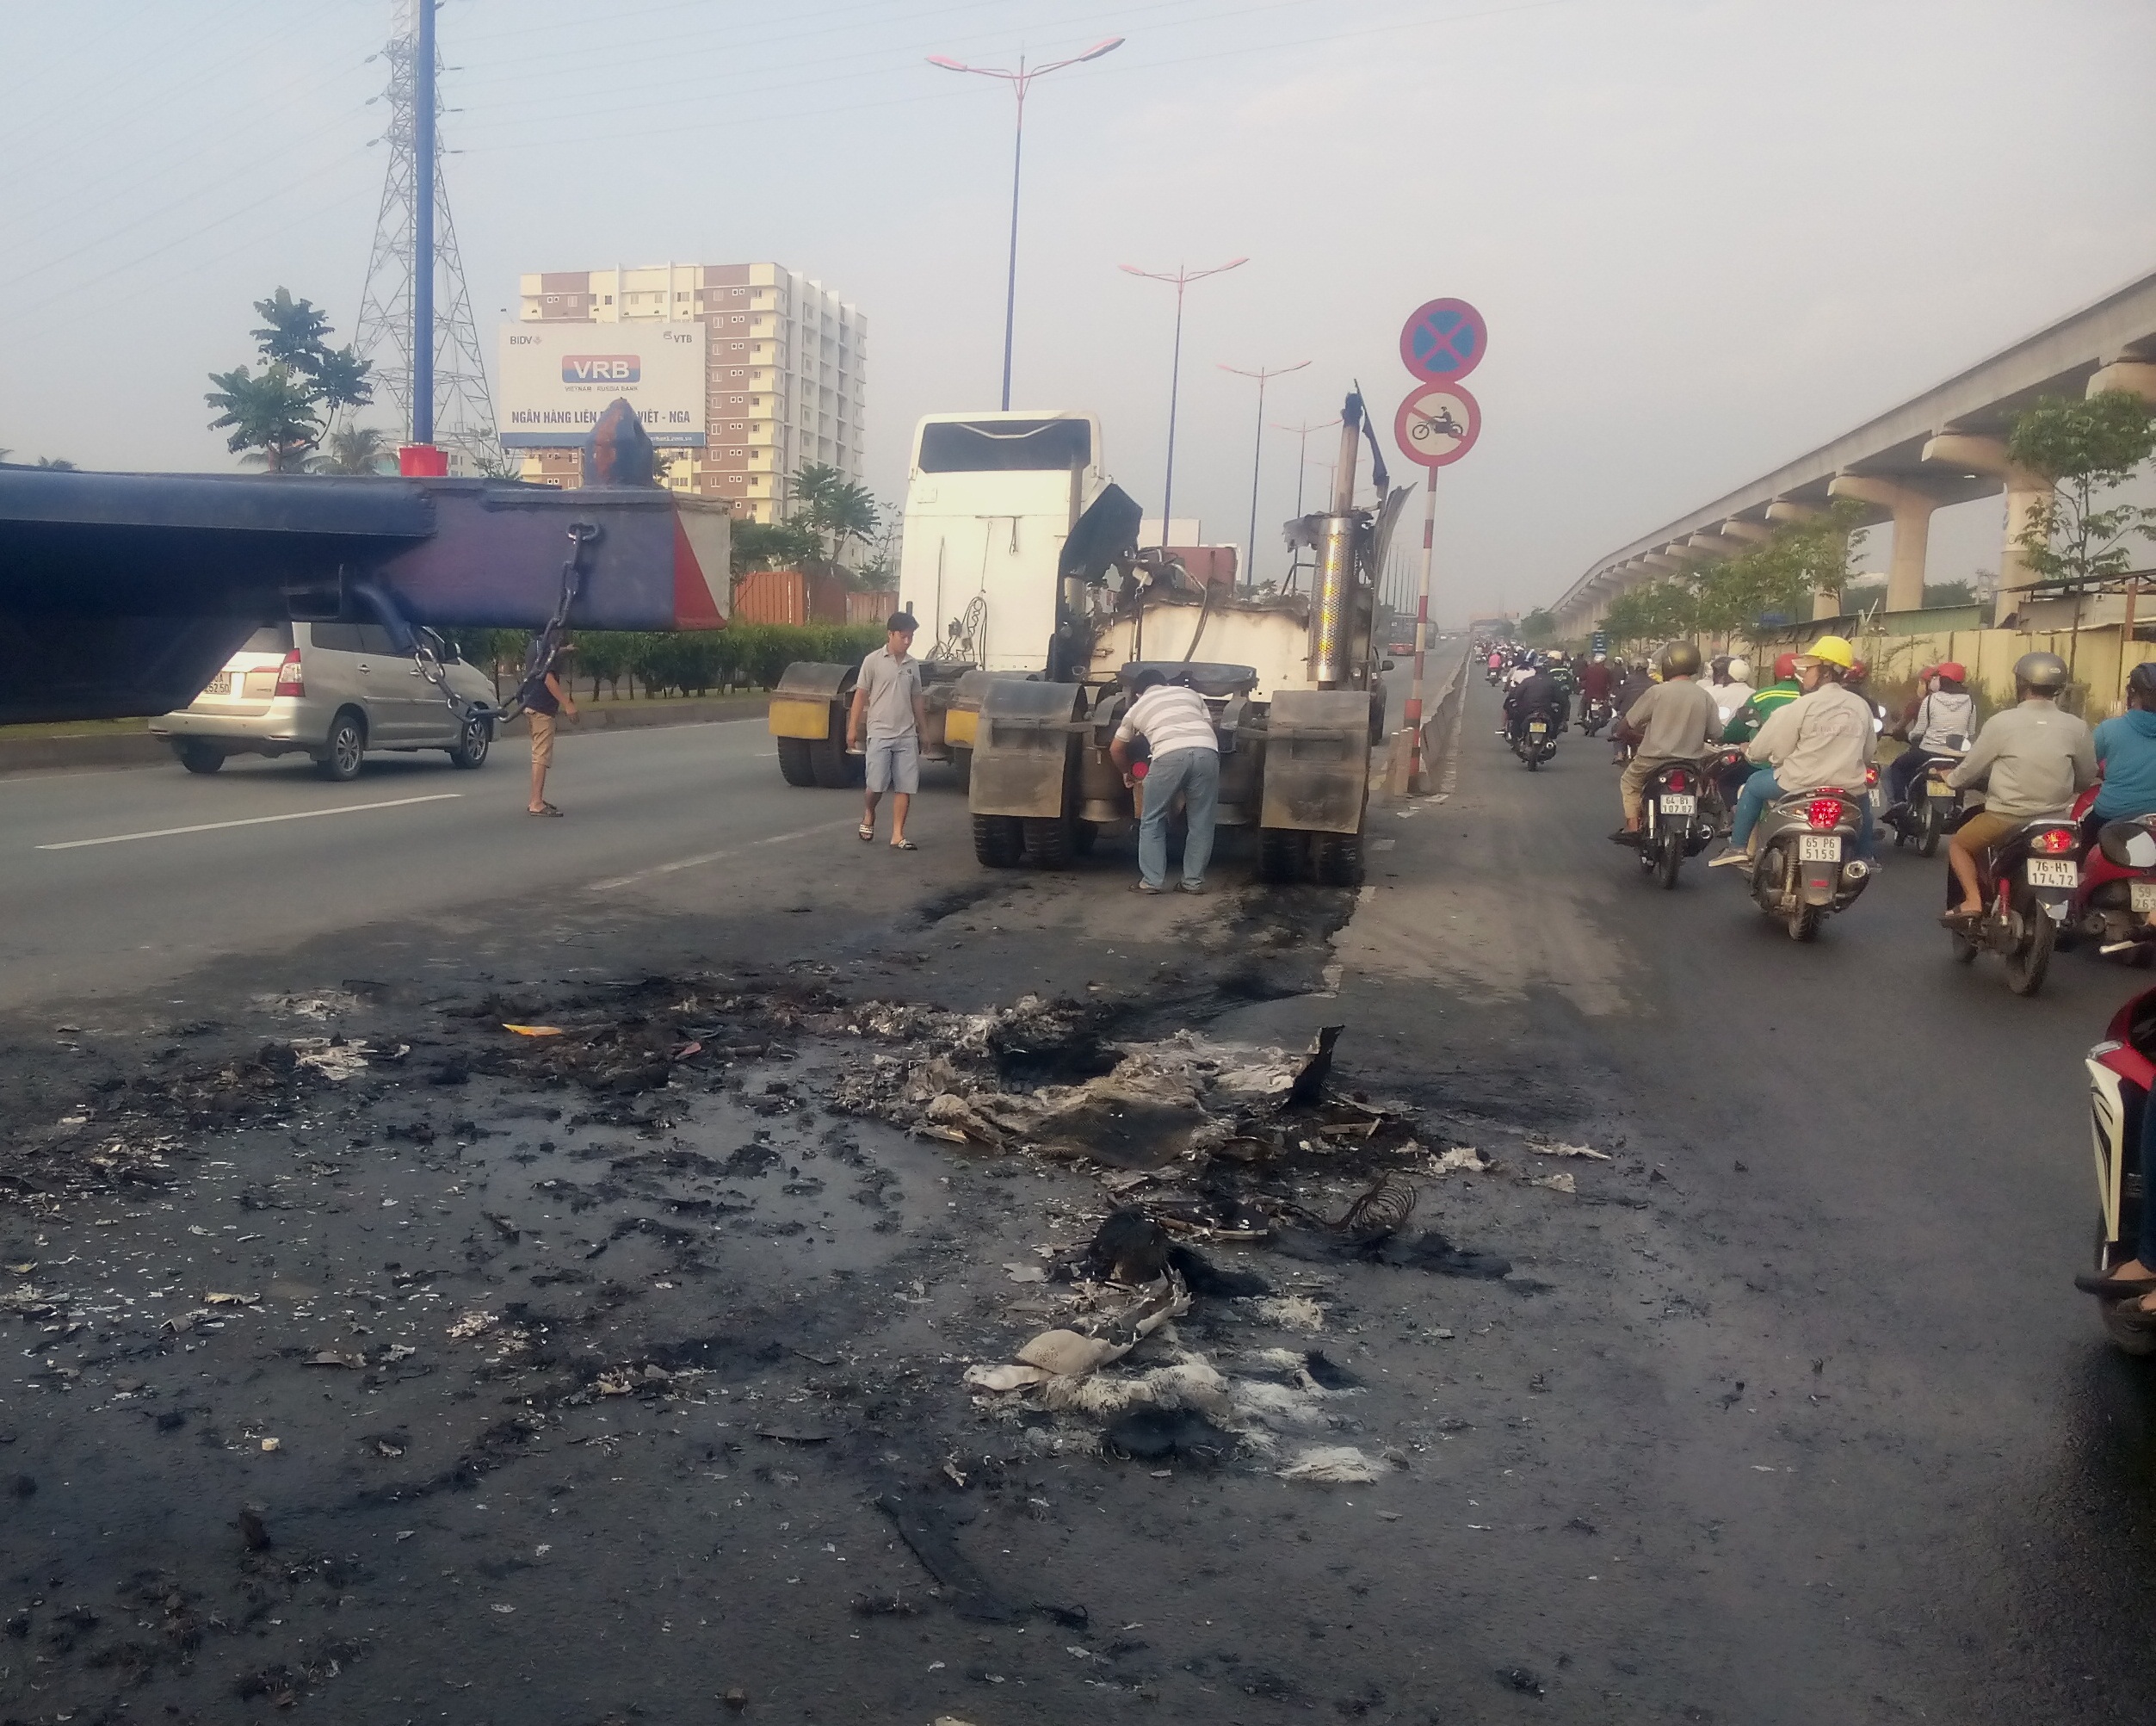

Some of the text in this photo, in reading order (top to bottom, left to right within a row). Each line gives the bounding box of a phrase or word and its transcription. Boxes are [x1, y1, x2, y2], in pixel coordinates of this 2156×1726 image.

[510, 336, 533, 344] BIDV
[673, 334, 693, 343] VTB
[572, 361, 630, 379] VRB
[511, 409, 540, 423] NGÂN
[544, 409, 571, 423] HÀNG
[575, 409, 597, 423] LIÊN
[669, 411, 690, 423] NGA
[1806, 849, 1835, 860] 5159
[2035, 861, 2068, 873] 76-H1
[2032, 873, 2074, 885] 174.72
